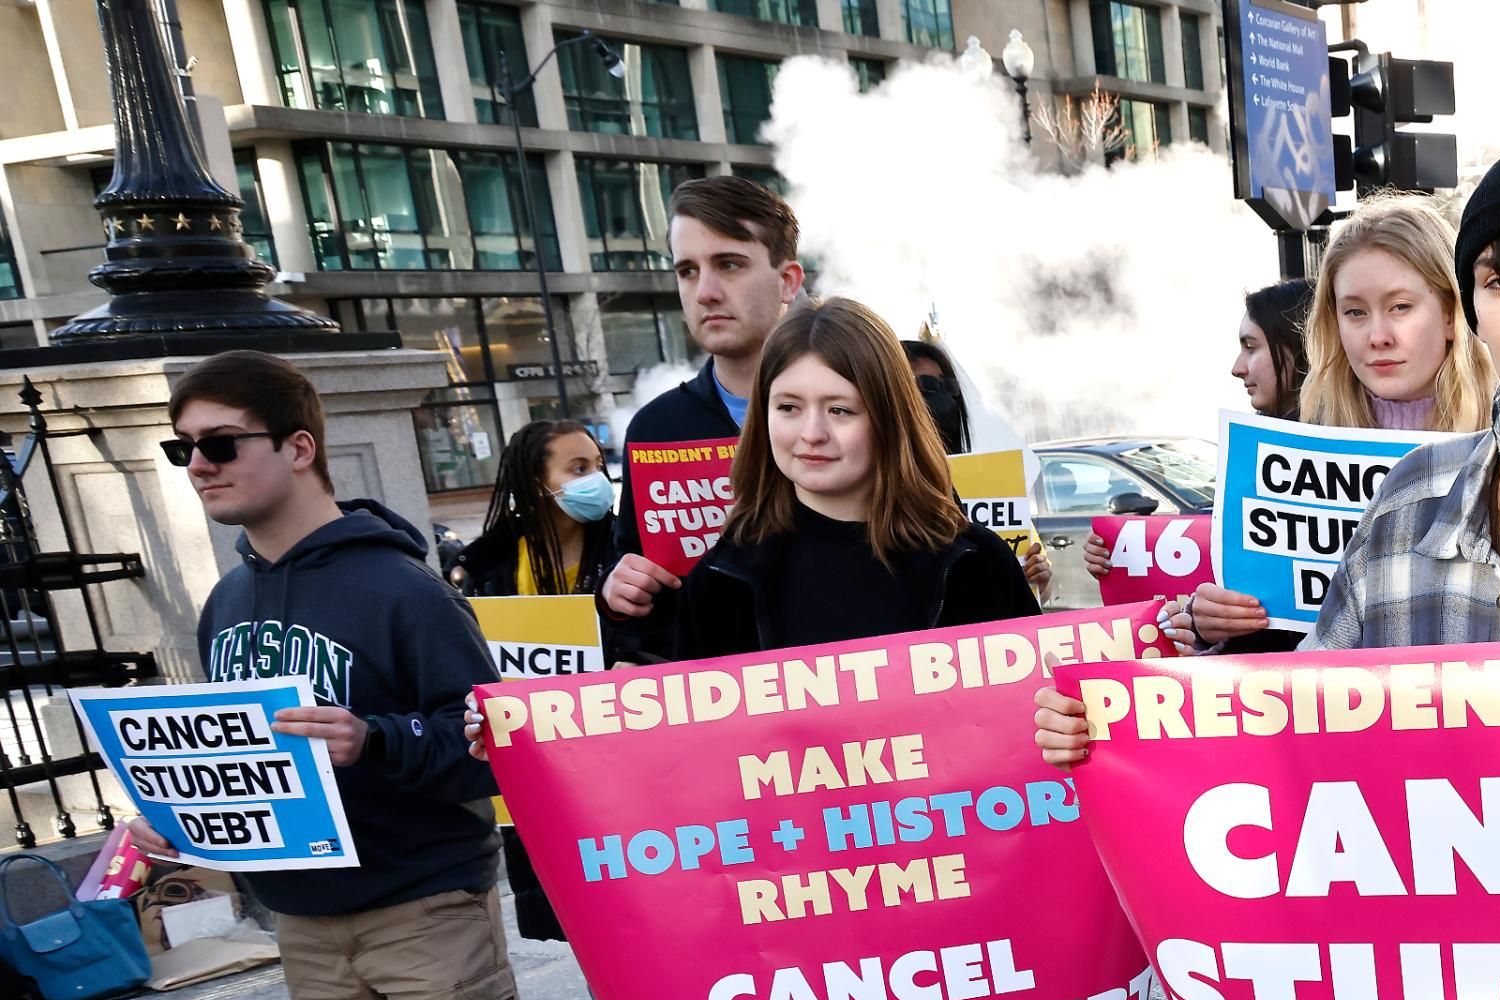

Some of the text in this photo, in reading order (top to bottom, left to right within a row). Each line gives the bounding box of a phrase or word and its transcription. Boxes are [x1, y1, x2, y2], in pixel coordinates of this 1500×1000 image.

[1257, 33, 1304, 56] The National Mall
[1258, 55, 1290, 72] World Bank
[1260, 75, 1305, 95] The White House
[631, 447, 712, 464] PRESIDENT
[649, 477, 736, 504] CANC
[1261, 453, 1392, 502] CANC
[644, 504, 735, 534] STUD
[962, 501, 1022, 527] CEL
[1110, 519, 1201, 577] 46
[500, 645, 588, 675] NCEL
[483, 617, 1160, 748] PRESIDENT BIDEN:
[119, 711, 271, 751] CANCEL
[130, 759, 294, 799] STUDENT
[738, 733, 929, 801] MAKE
[178, 809, 272, 845] DEBT
[577, 818, 755, 883] HOPE
[771, 819, 805, 851] +
[736, 853, 971, 925] RHYME
